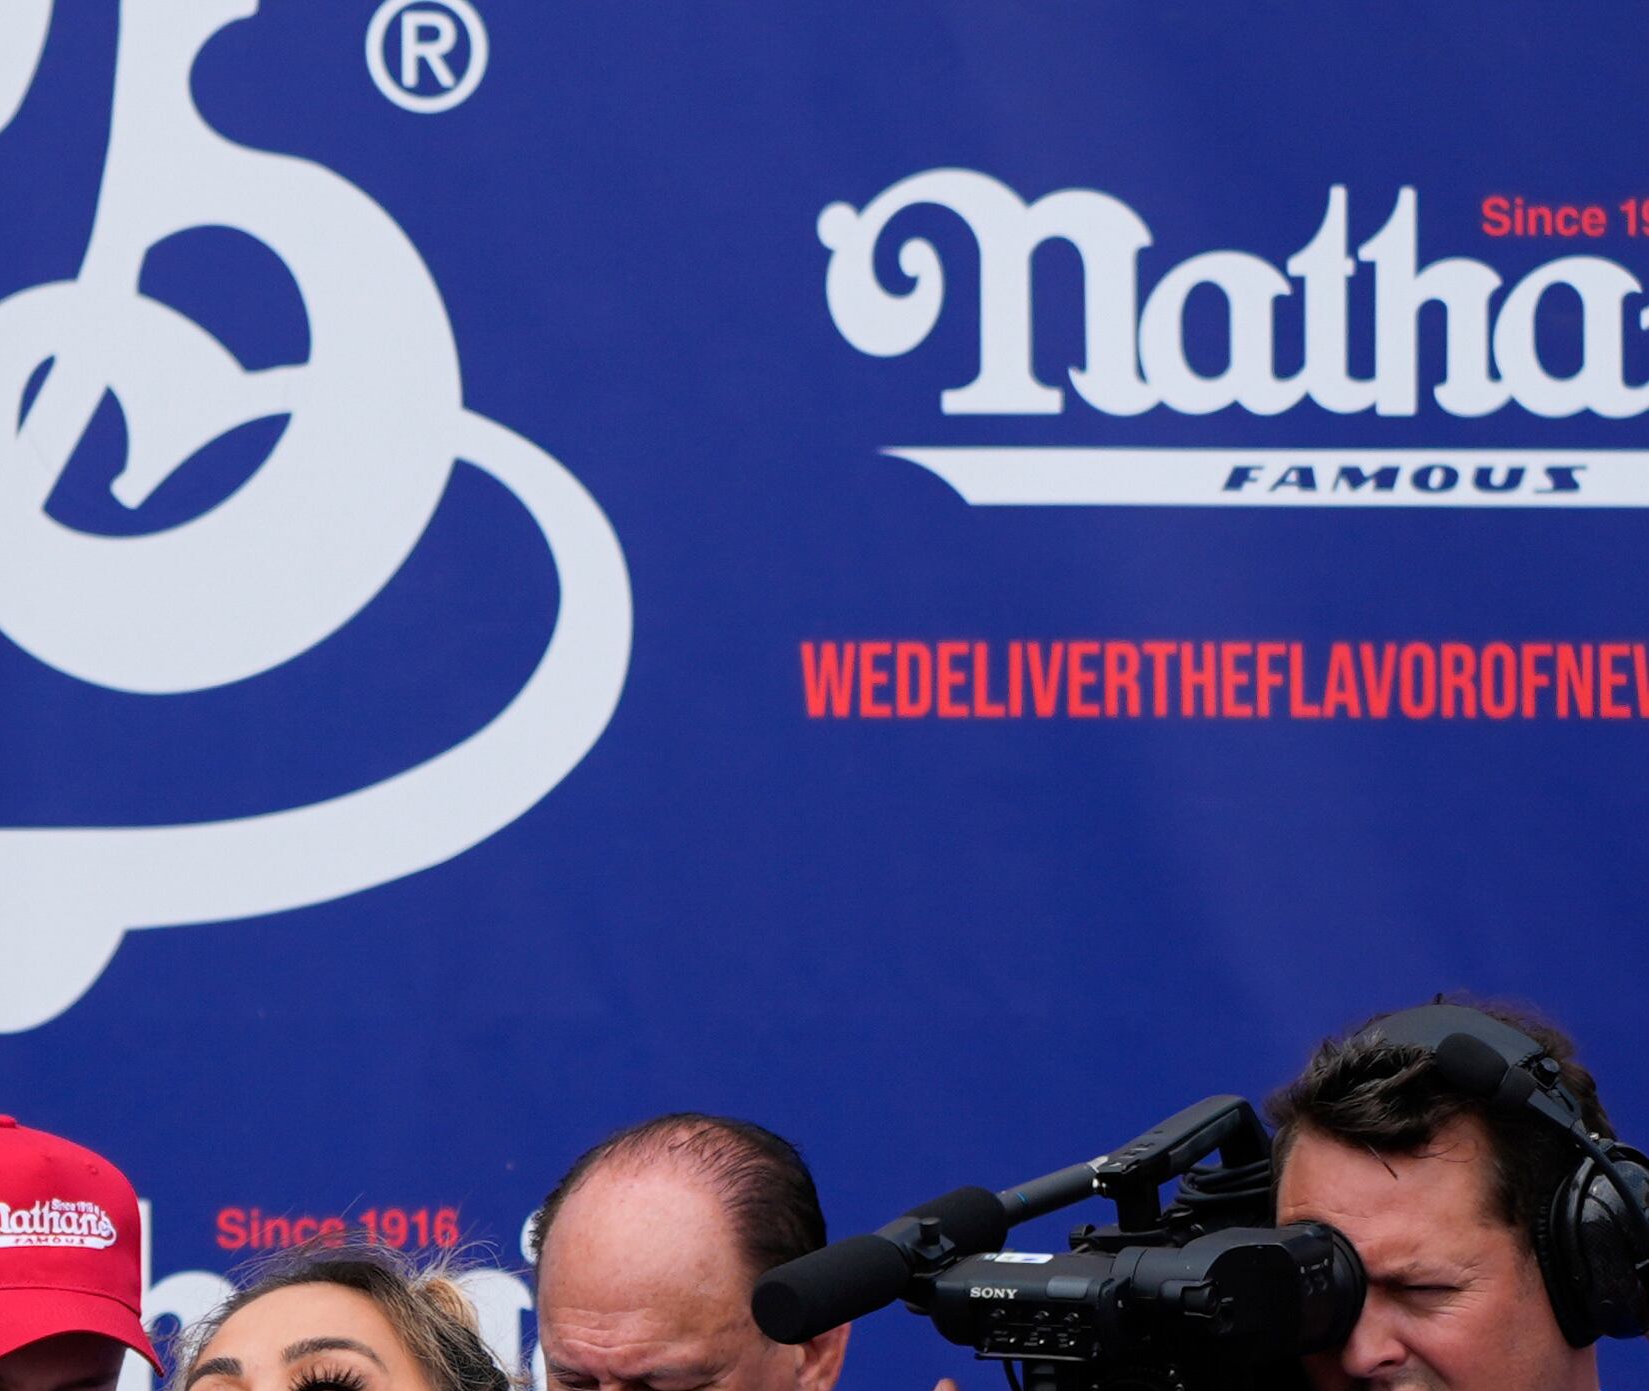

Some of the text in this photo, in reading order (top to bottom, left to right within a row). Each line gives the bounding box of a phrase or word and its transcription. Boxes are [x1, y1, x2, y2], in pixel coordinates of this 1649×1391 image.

[1482, 195, 1607, 237] Since
[817, 168, 1649, 419] Natha
[1221, 464, 1588, 494] FAMOUS
[216, 1206, 459, 1249] Since 1916
[970, 1287, 1018, 1299] SONY
